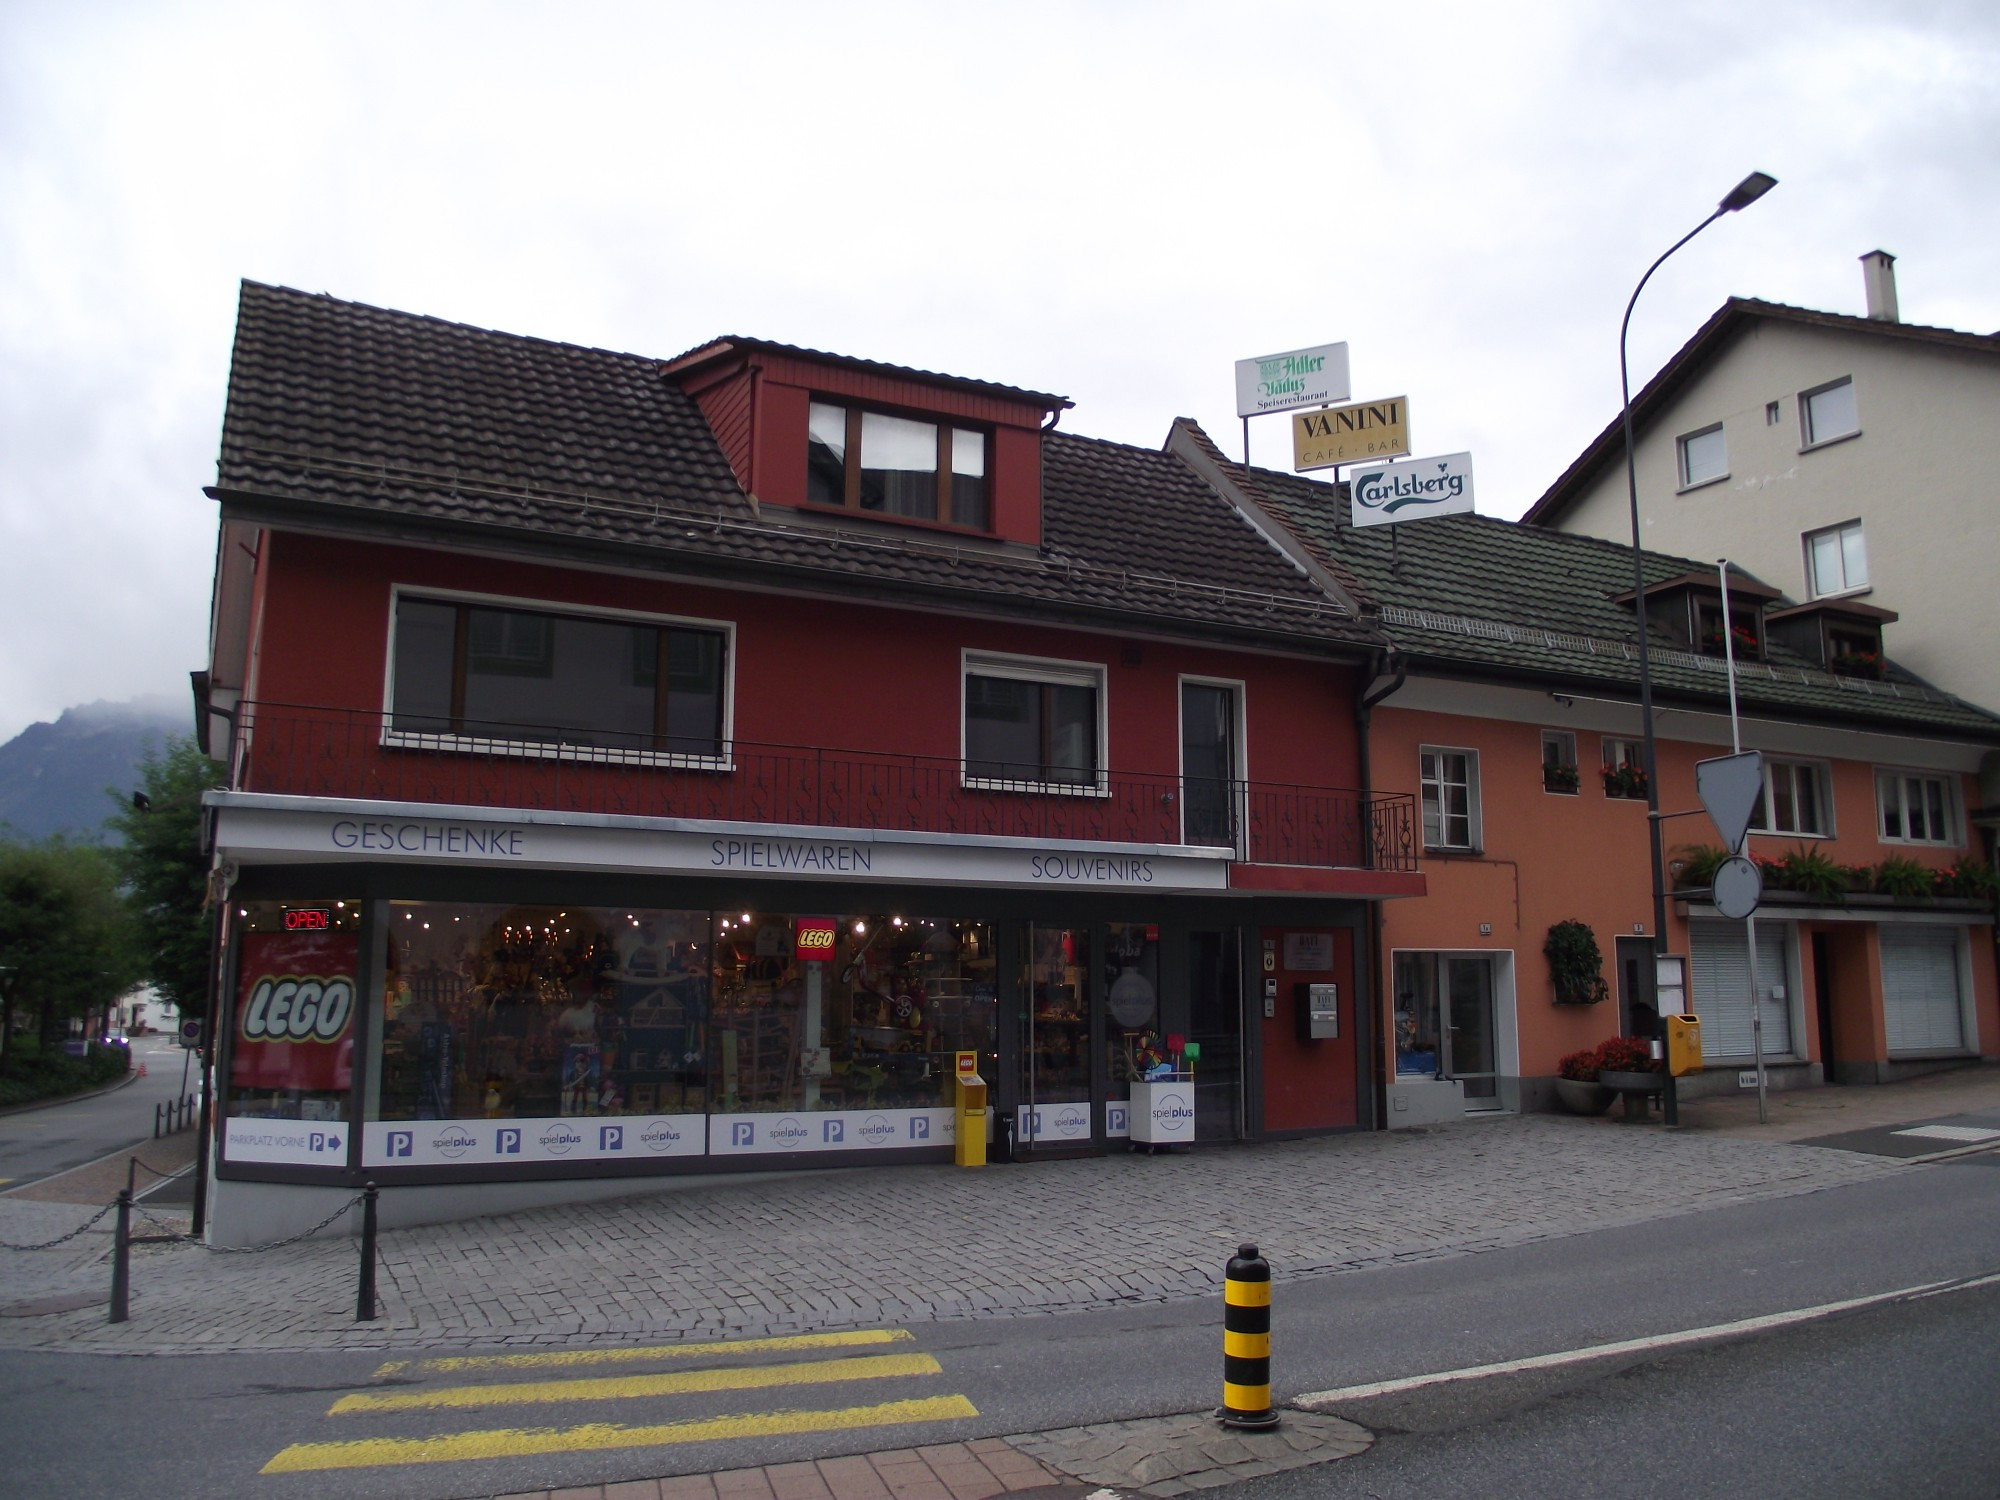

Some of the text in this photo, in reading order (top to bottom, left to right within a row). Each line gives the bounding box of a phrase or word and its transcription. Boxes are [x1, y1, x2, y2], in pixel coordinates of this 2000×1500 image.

[1275, 353, 1325, 377] Adler
[1257, 390, 1328, 409] Speiserestaurant
[1302, 402, 1400, 439] VANINI
[1302, 438, 1399, 463] CAFÉ BAR
[1355, 470, 1464, 510] Carlsberg
[332, 820, 524, 857] GESCHENKE
[711, 840, 872, 872] SPIELWAREN
[1031, 854, 1153, 883] SOUVENIRS
[286, 911, 327, 929] OPEN
[797, 928, 836, 949] LEGO
[244, 977, 354, 1040] LEGO
[1054, 1116, 1086, 1128] spielplus
[1110, 1110, 1125, 1130] P
[1152, 1105, 1194, 1121] spielplus
[538, 1129, 582, 1146] spielplus
[602, 1127, 621, 1150] P
[640, 1127, 681, 1143] spielplus
[735, 1123, 753, 1146] P
[769, 1124, 808, 1138] spielplus
[825, 1120, 843, 1142] P
[858, 1121, 895, 1135] spielplus
[911, 1117, 928, 1139] P
[229, 1133, 273, 1148] PARKPLATZ
[273, 1135, 305, 1148] VORNE
[390, 1132, 411, 1157] P
[432, 1132, 477, 1149] spielplus
[499, 1130, 519, 1153] P
